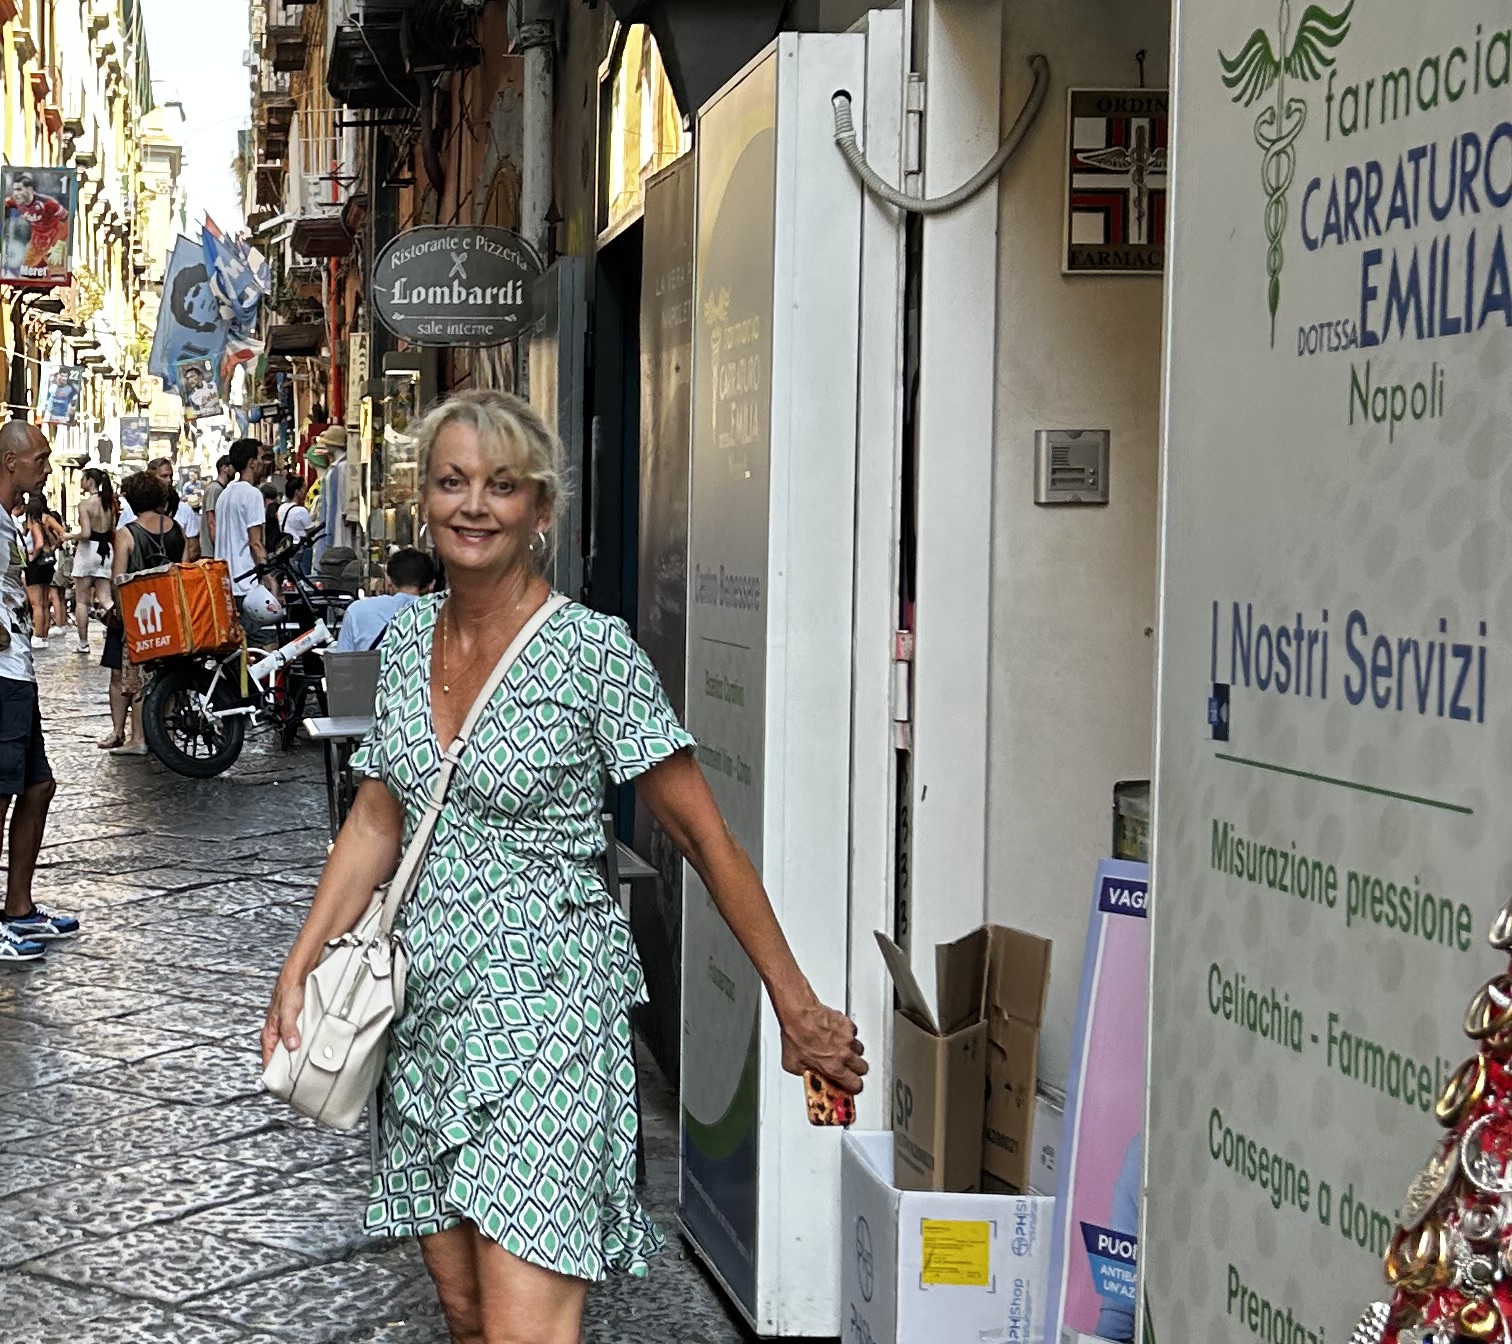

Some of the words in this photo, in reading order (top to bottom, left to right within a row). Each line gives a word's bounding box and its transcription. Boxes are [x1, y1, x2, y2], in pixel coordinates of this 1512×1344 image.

[1325, 22, 1512, 142] farmacia
[1300, 122, 1512, 252] CARRATURO
[390, 235, 459, 270] Ristorante
[462, 238, 471, 250] e
[475, 234, 529, 272] Pizzeria
[390, 276, 524, 306] Lombardi
[1358, 225, 1512, 350] EMILIA
[416, 321, 443, 336] sale
[447, 322, 495, 336] interne
[1348, 358, 1445, 444] Napoli
[136, 638, 154, 653] JUST
[155, 635, 172, 647] EAT
[1231, 601, 1329, 700] Nostri
[1344, 608, 1488, 724] Servizi
[1211, 818, 1338, 910] Misurazione
[1346, 868, 1473, 953] pressione
[1207, 961, 1303, 1054] Celiachia
[1327, 1010, 1454, 1112] Farmaceli
[1208, 1107, 1311, 1212] Consegne
[1317, 1182, 1331, 1227] a
